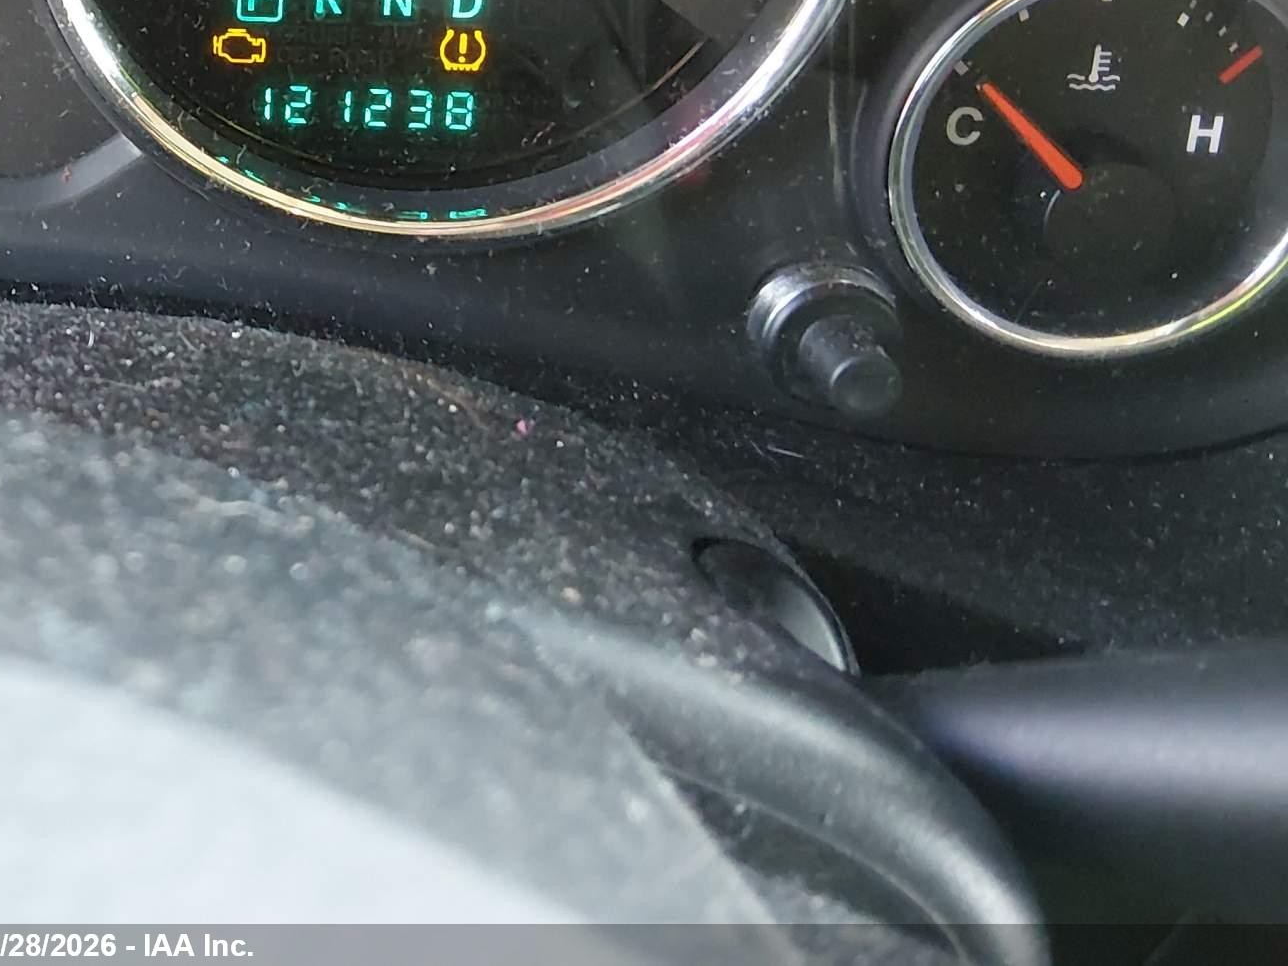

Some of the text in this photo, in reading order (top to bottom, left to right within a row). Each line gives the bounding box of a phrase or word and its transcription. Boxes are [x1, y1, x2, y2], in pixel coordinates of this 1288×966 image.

[263, 85, 474, 131] 121238
[946, 106, 984, 146] C
[1186, 114, 1224, 154] H
